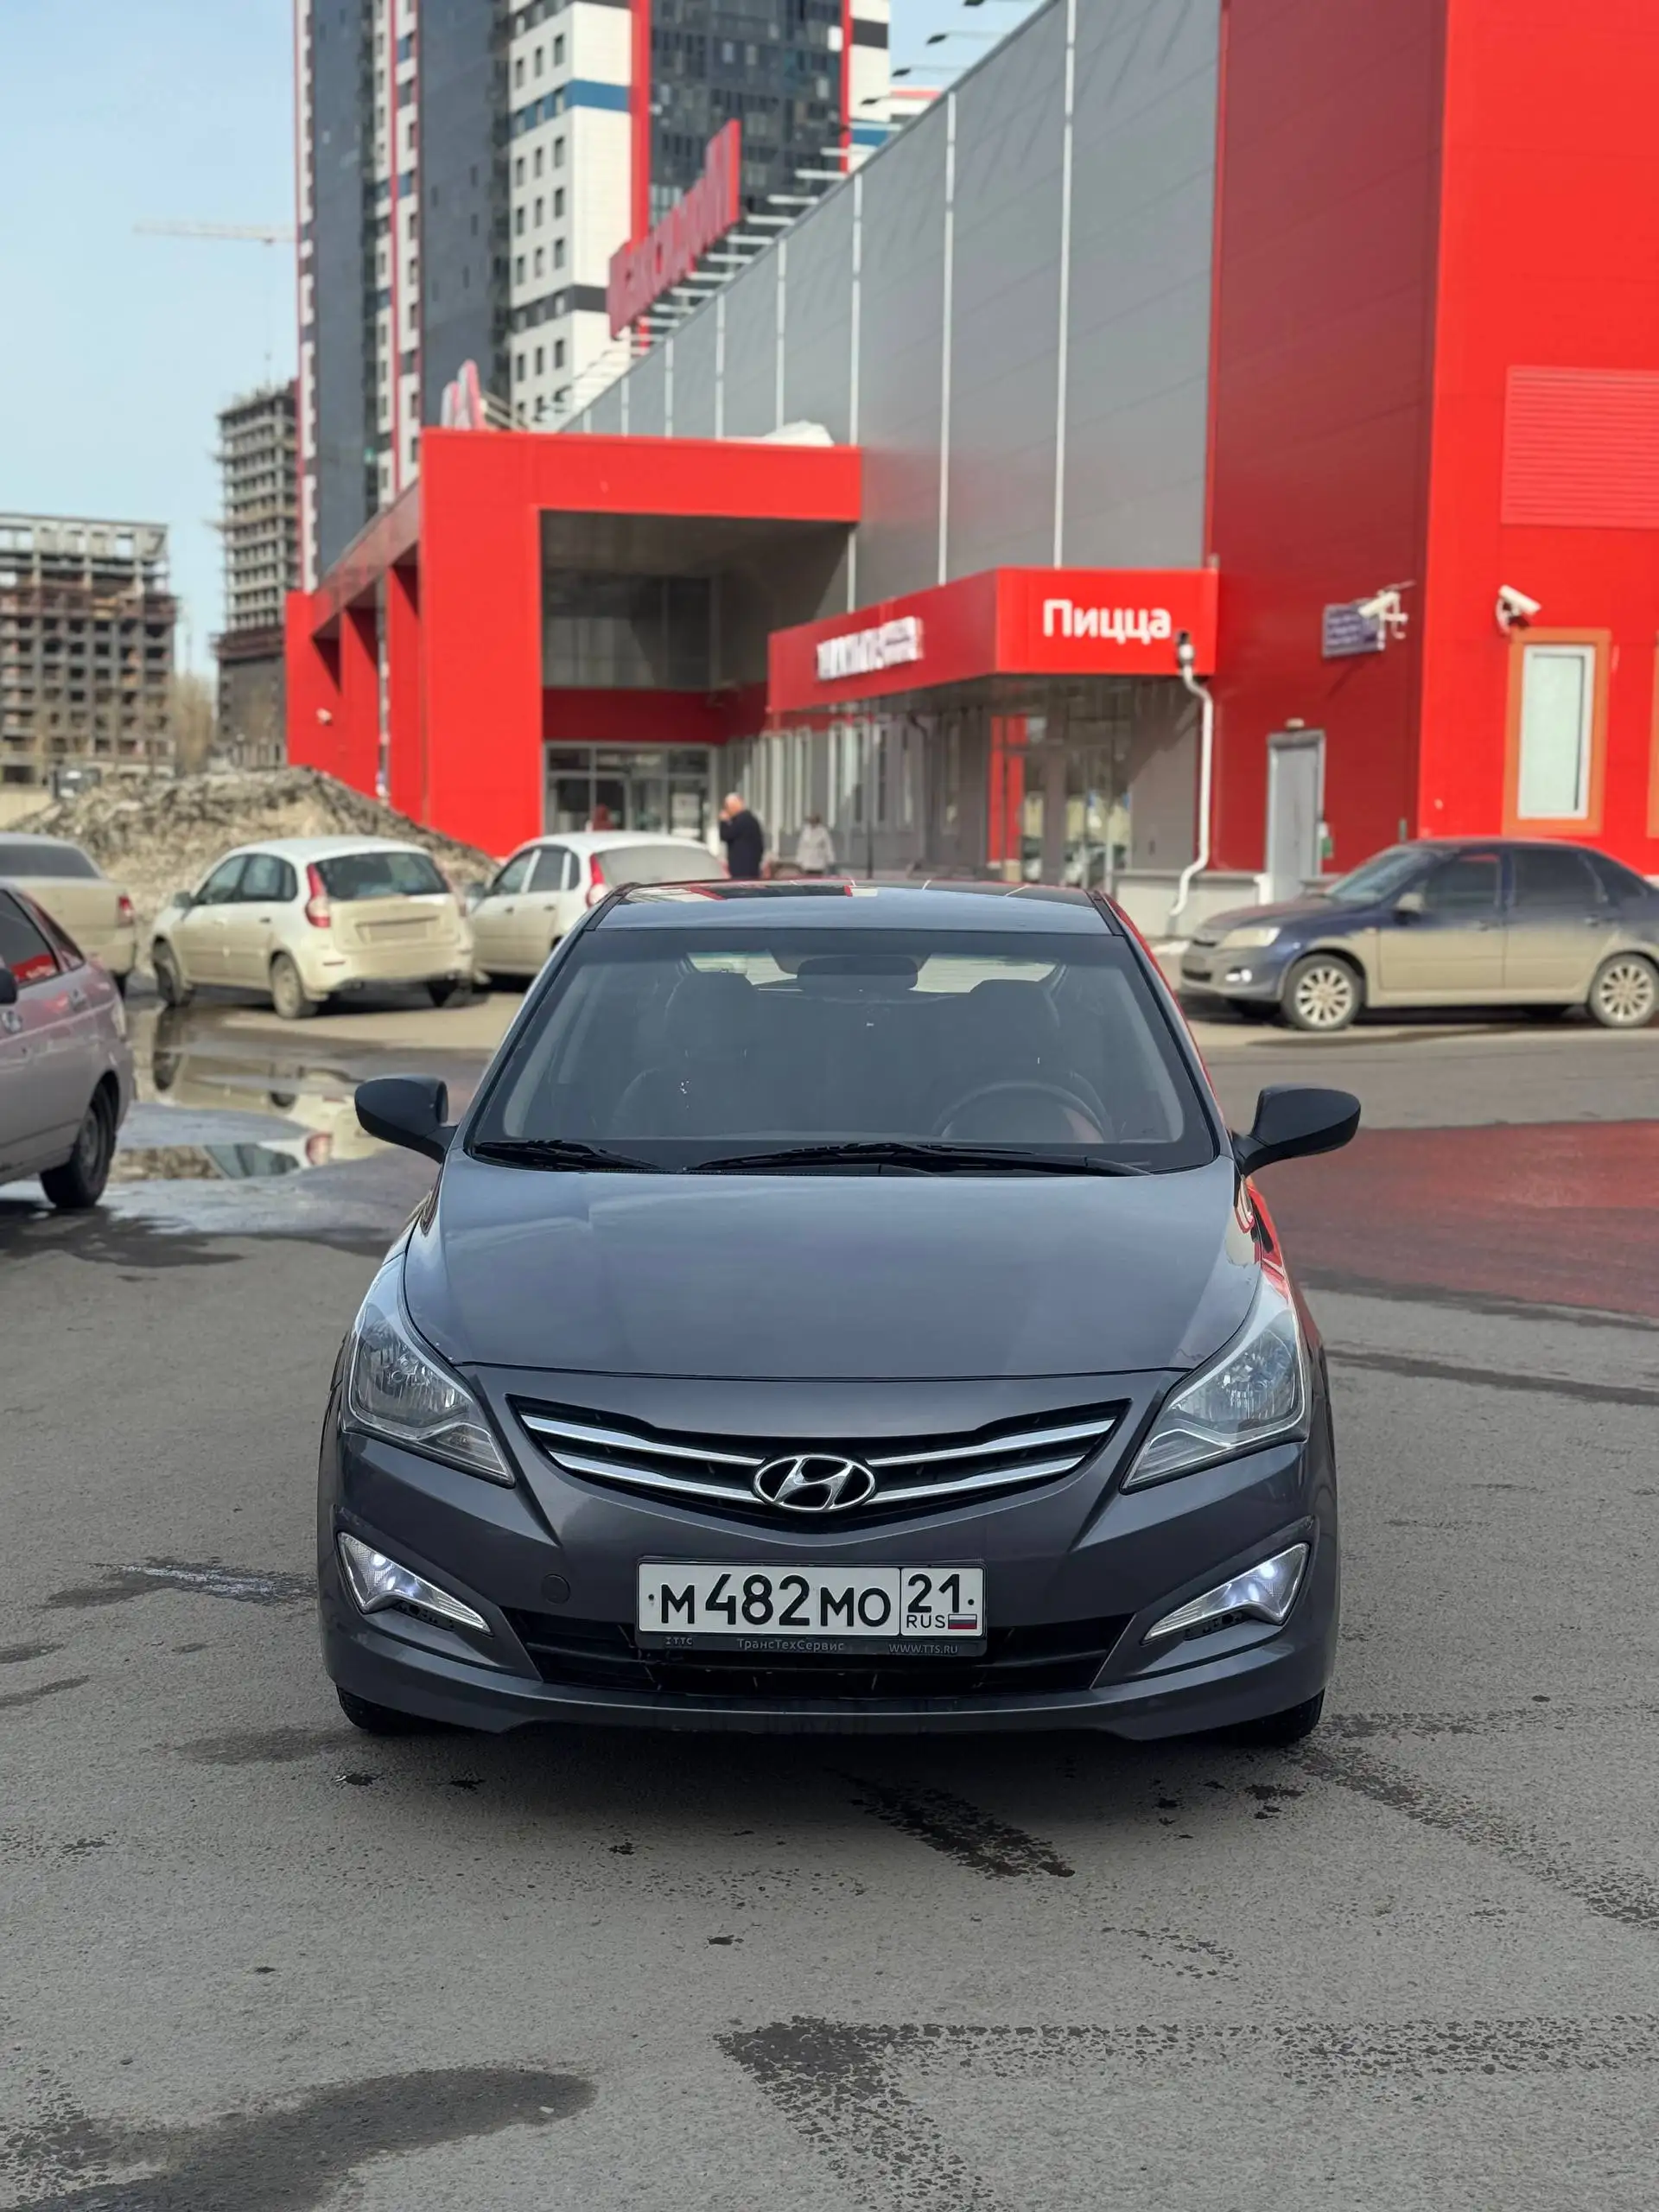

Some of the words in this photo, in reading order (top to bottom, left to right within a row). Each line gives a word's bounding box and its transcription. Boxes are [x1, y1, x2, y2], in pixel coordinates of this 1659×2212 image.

[1043, 599, 1171, 645] Пицца
[907, 1573, 961, 1612] 21
[906, 1614, 945, 1630] RUS
[737, 1638, 844, 1652] ТрансТехСервис
[888, 1643, 959, 1654] WWW.TTS.RU
